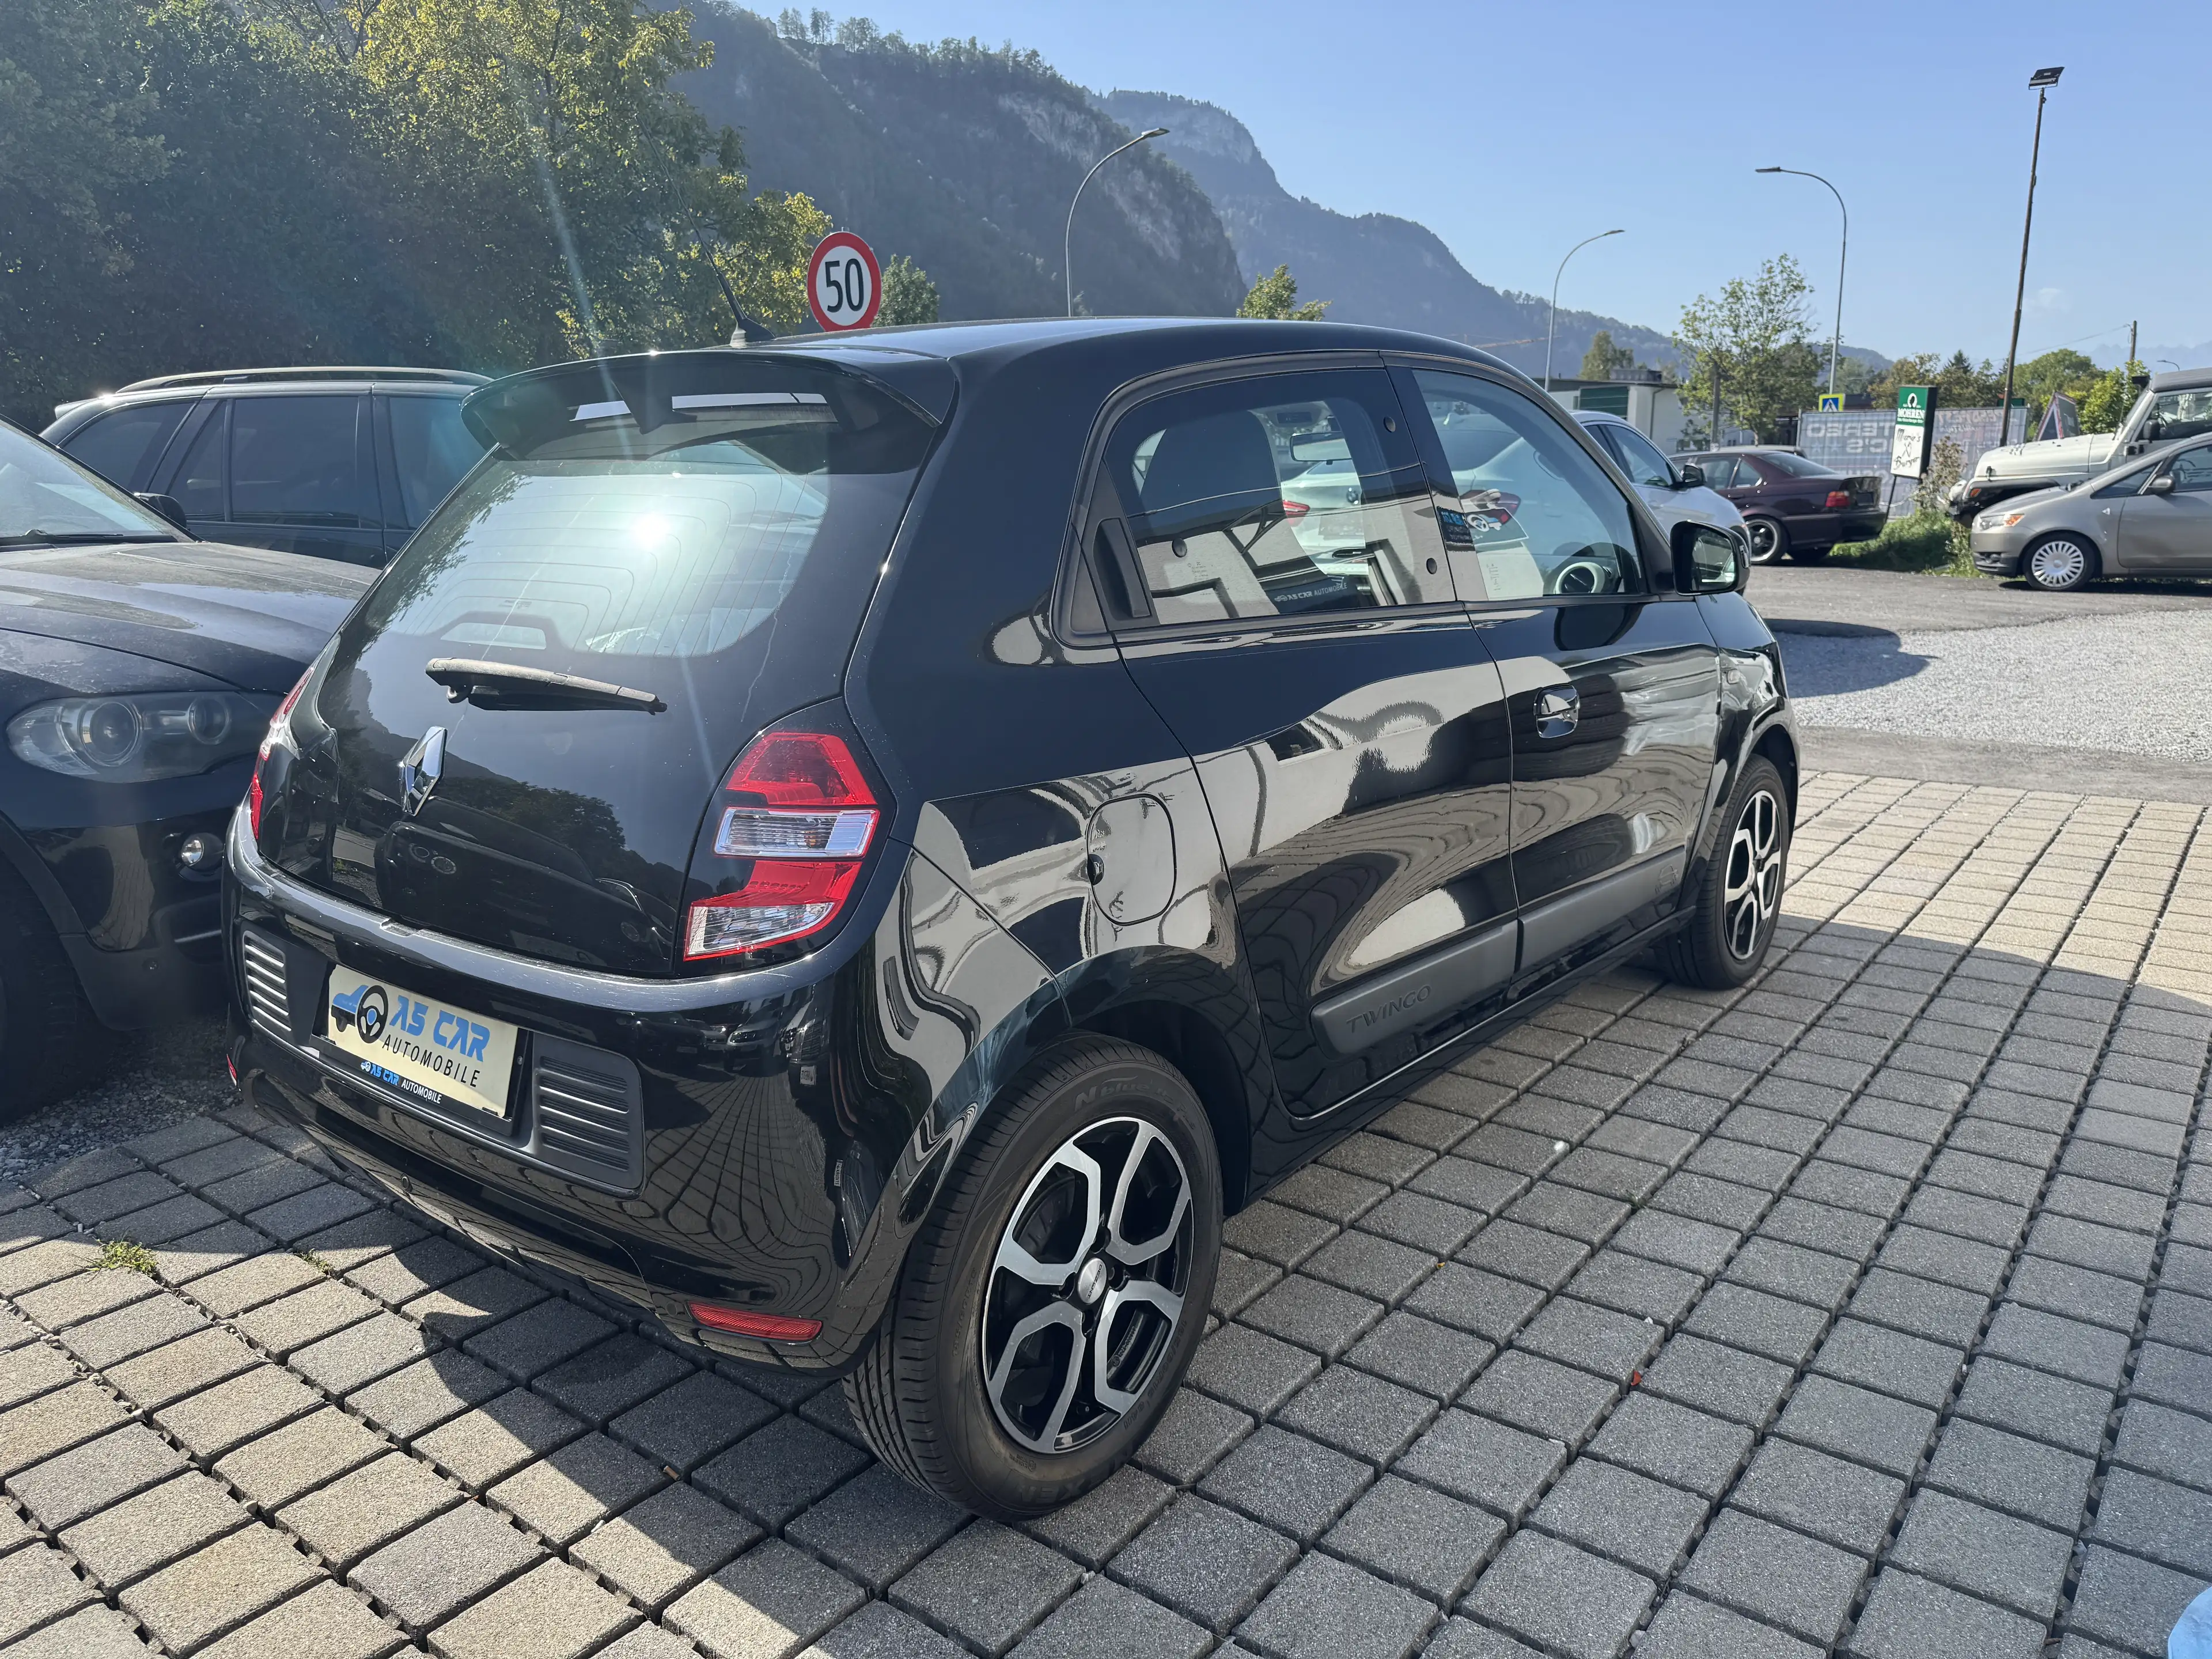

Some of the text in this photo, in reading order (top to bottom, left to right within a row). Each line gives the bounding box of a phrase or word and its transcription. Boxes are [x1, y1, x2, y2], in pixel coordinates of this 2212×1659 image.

[825, 258, 864, 313] 50
[1897, 408, 1925, 419] MOHREN
[1314, 582, 1347, 596] AUTOMOBILE
[389, 995, 491, 1062] AS CAR
[1346, 984, 1432, 1033] TWINGO
[370, 1063, 442, 1104] AS CAR AUTOMOBILE
[381, 1034, 481, 1088] AUTOMOBILE
[1087, 1264, 1103, 1299] DEZENT
